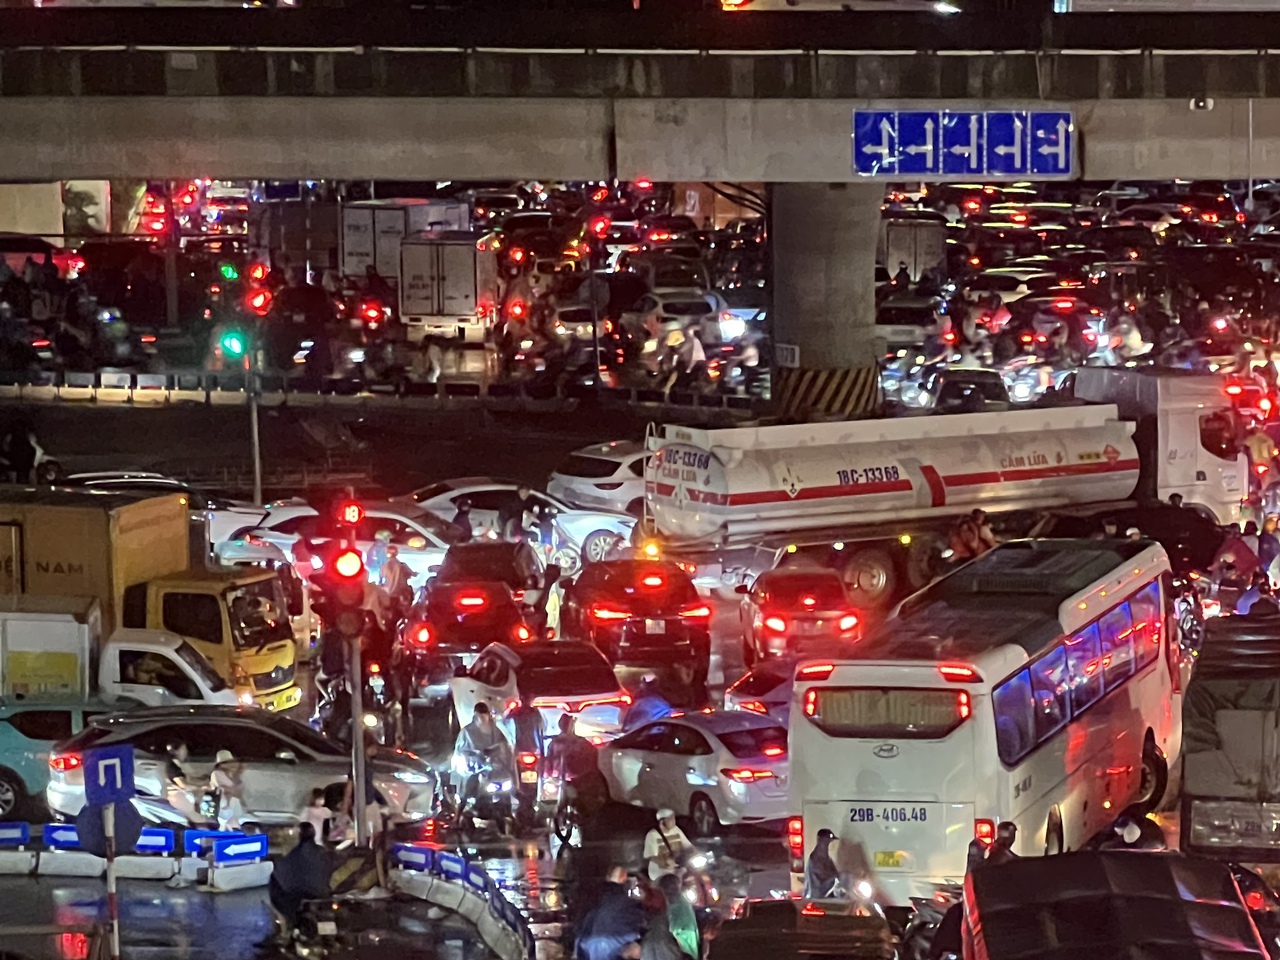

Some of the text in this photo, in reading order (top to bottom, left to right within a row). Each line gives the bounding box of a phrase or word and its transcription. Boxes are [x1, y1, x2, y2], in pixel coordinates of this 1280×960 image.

[345, 505, 359, 523] 18
[36, 562, 84, 575] NAM
[850, 808, 927, 823] 29B-406.48
